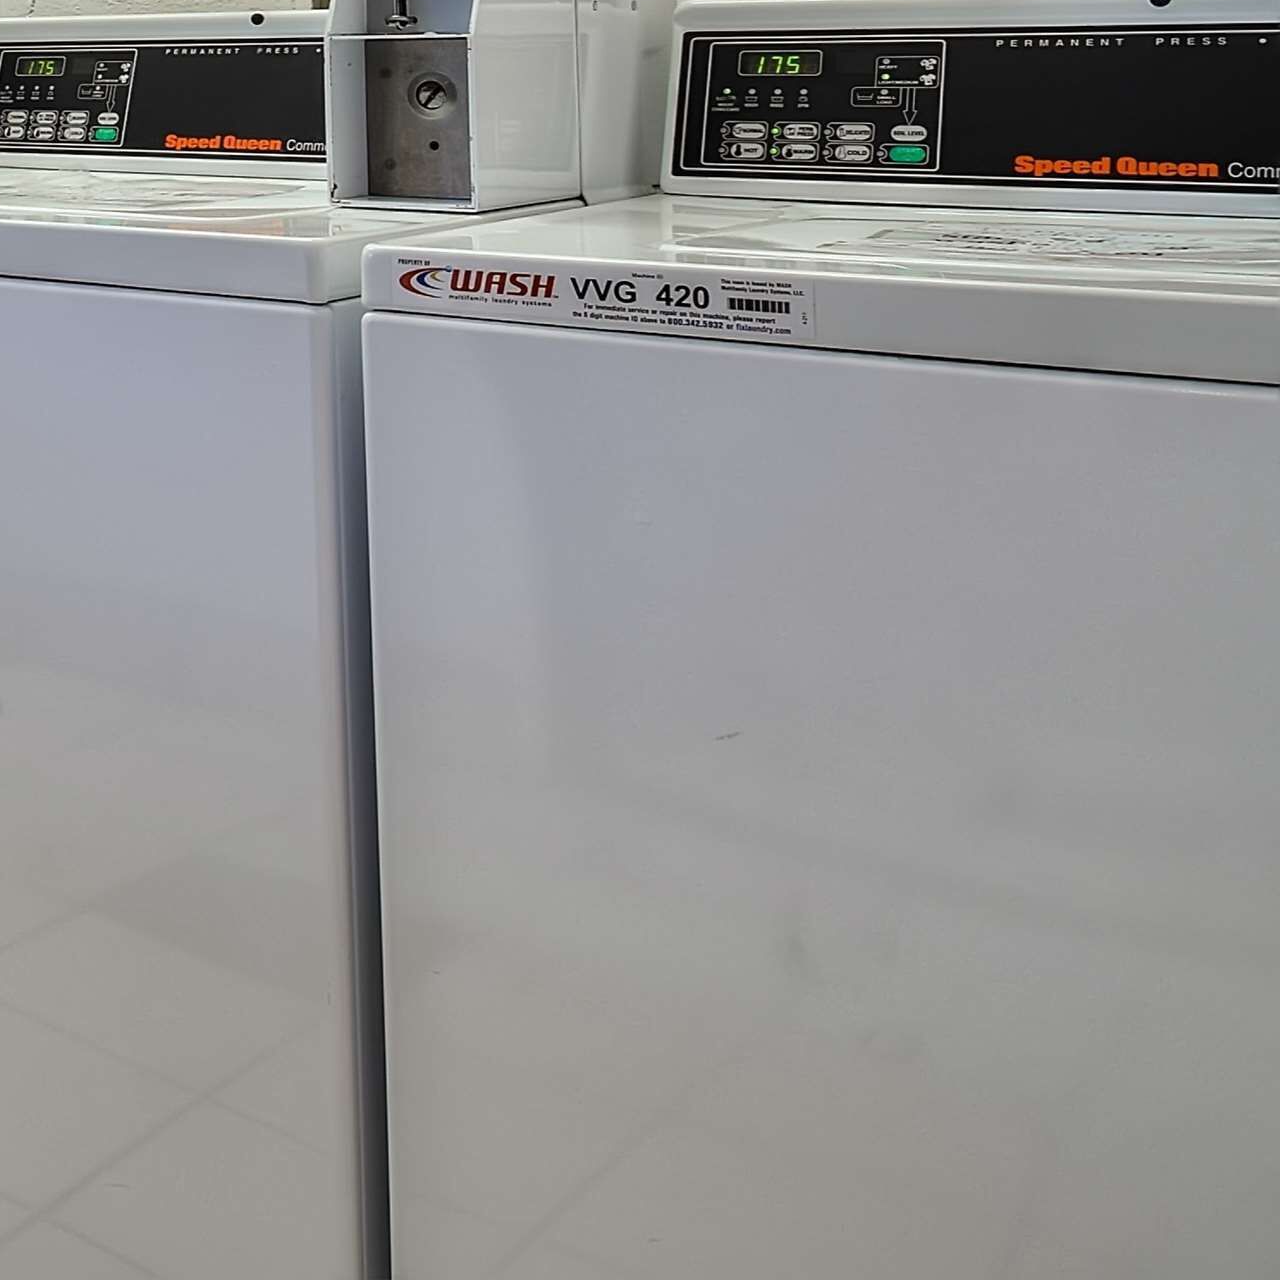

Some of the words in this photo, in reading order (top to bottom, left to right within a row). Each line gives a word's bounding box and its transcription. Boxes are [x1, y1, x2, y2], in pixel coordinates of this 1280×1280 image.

[995, 37, 1125, 48] PERMANENT
[1155, 36, 1228, 47] PRESS
[165, 47, 241, 55] PERMANENT
[256, 47, 300, 55] PRESS
[28, 60, 55, 75] 175
[757, 55, 801, 74] 175
[164, 134, 222, 151] Speed
[222, 134, 283, 151] Queen
[286, 139, 327, 152] Comm
[847, 149, 867, 157] COLD
[1014, 155, 1112, 177] Speed
[1116, 156, 1220, 178] Queen
[450, 269, 556, 298] WASH
[448, 294, 489, 304] multifamily
[491, 296, 518, 306] laundry
[570, 277, 637, 304] VVG
[656, 283, 710, 310] 420
